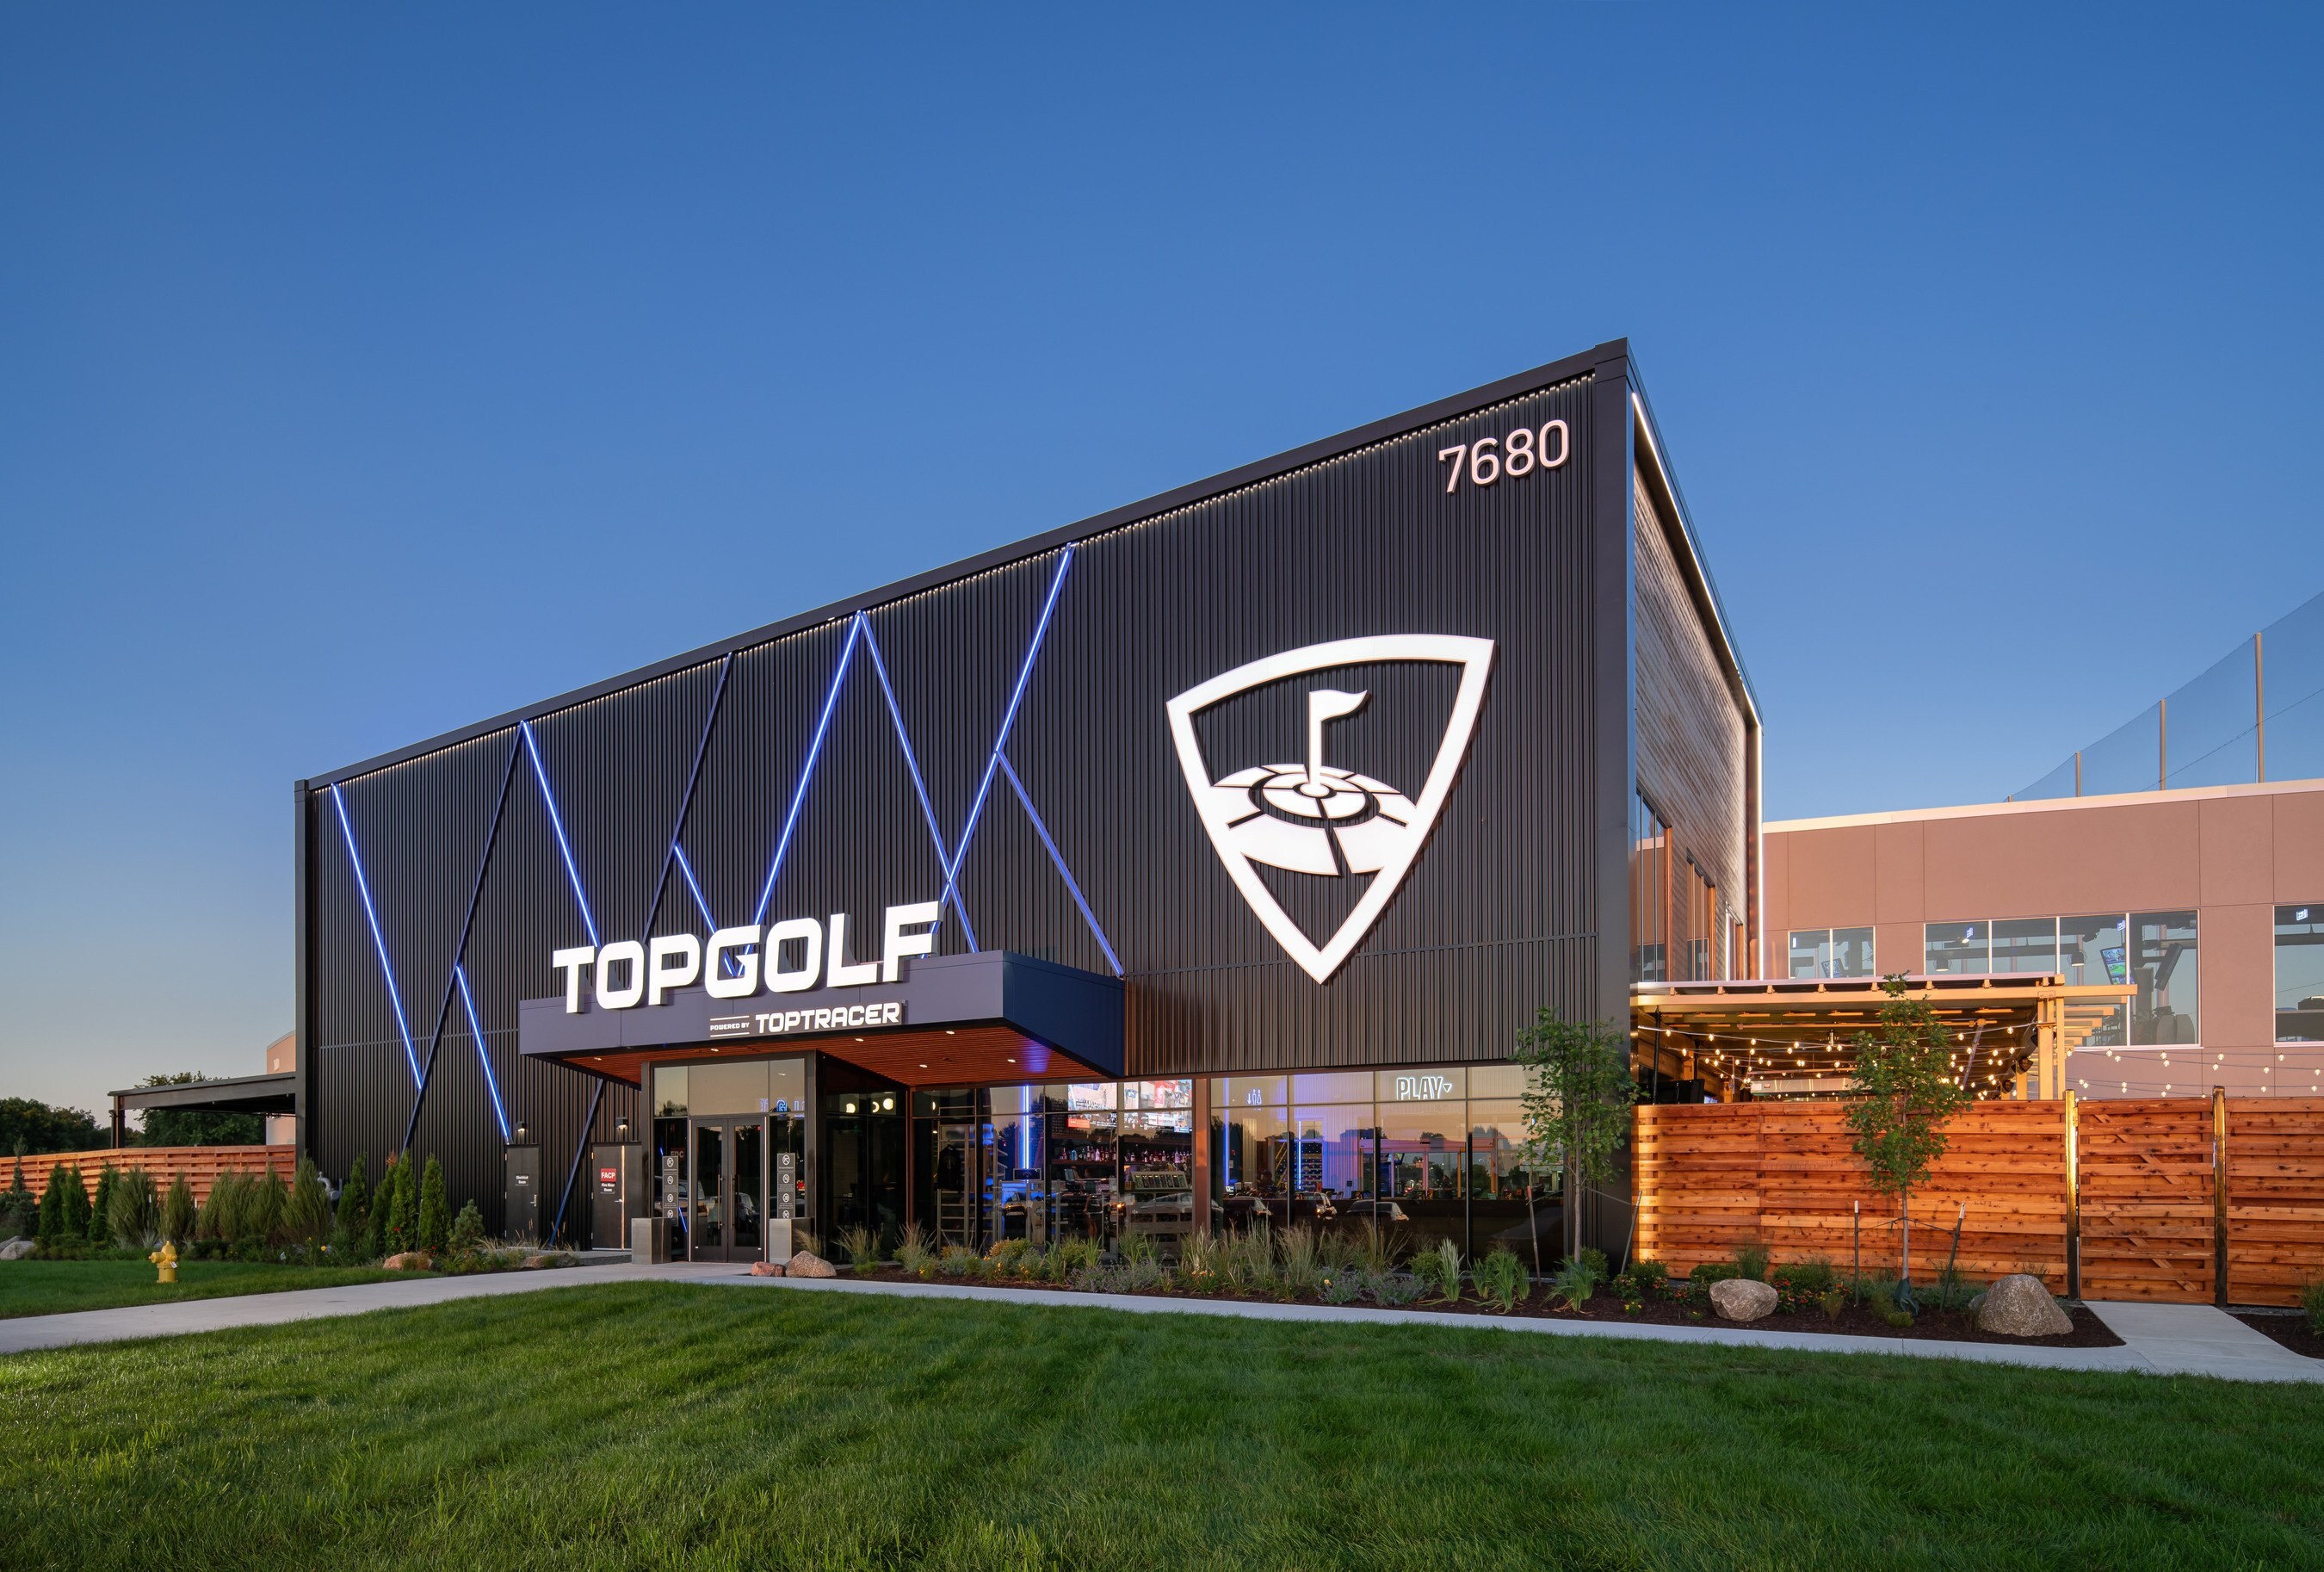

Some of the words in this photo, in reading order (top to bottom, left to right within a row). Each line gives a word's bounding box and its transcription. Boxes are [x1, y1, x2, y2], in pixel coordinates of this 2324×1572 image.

[1438, 419, 1570, 494] 7680
[552, 900, 942, 1014] TOPGOLF
[710, 1023, 740, 1031] POWERED
[755, 1002, 901, 1034] TOPTRACER
[1396, 1076, 1443, 1100] PLAY
